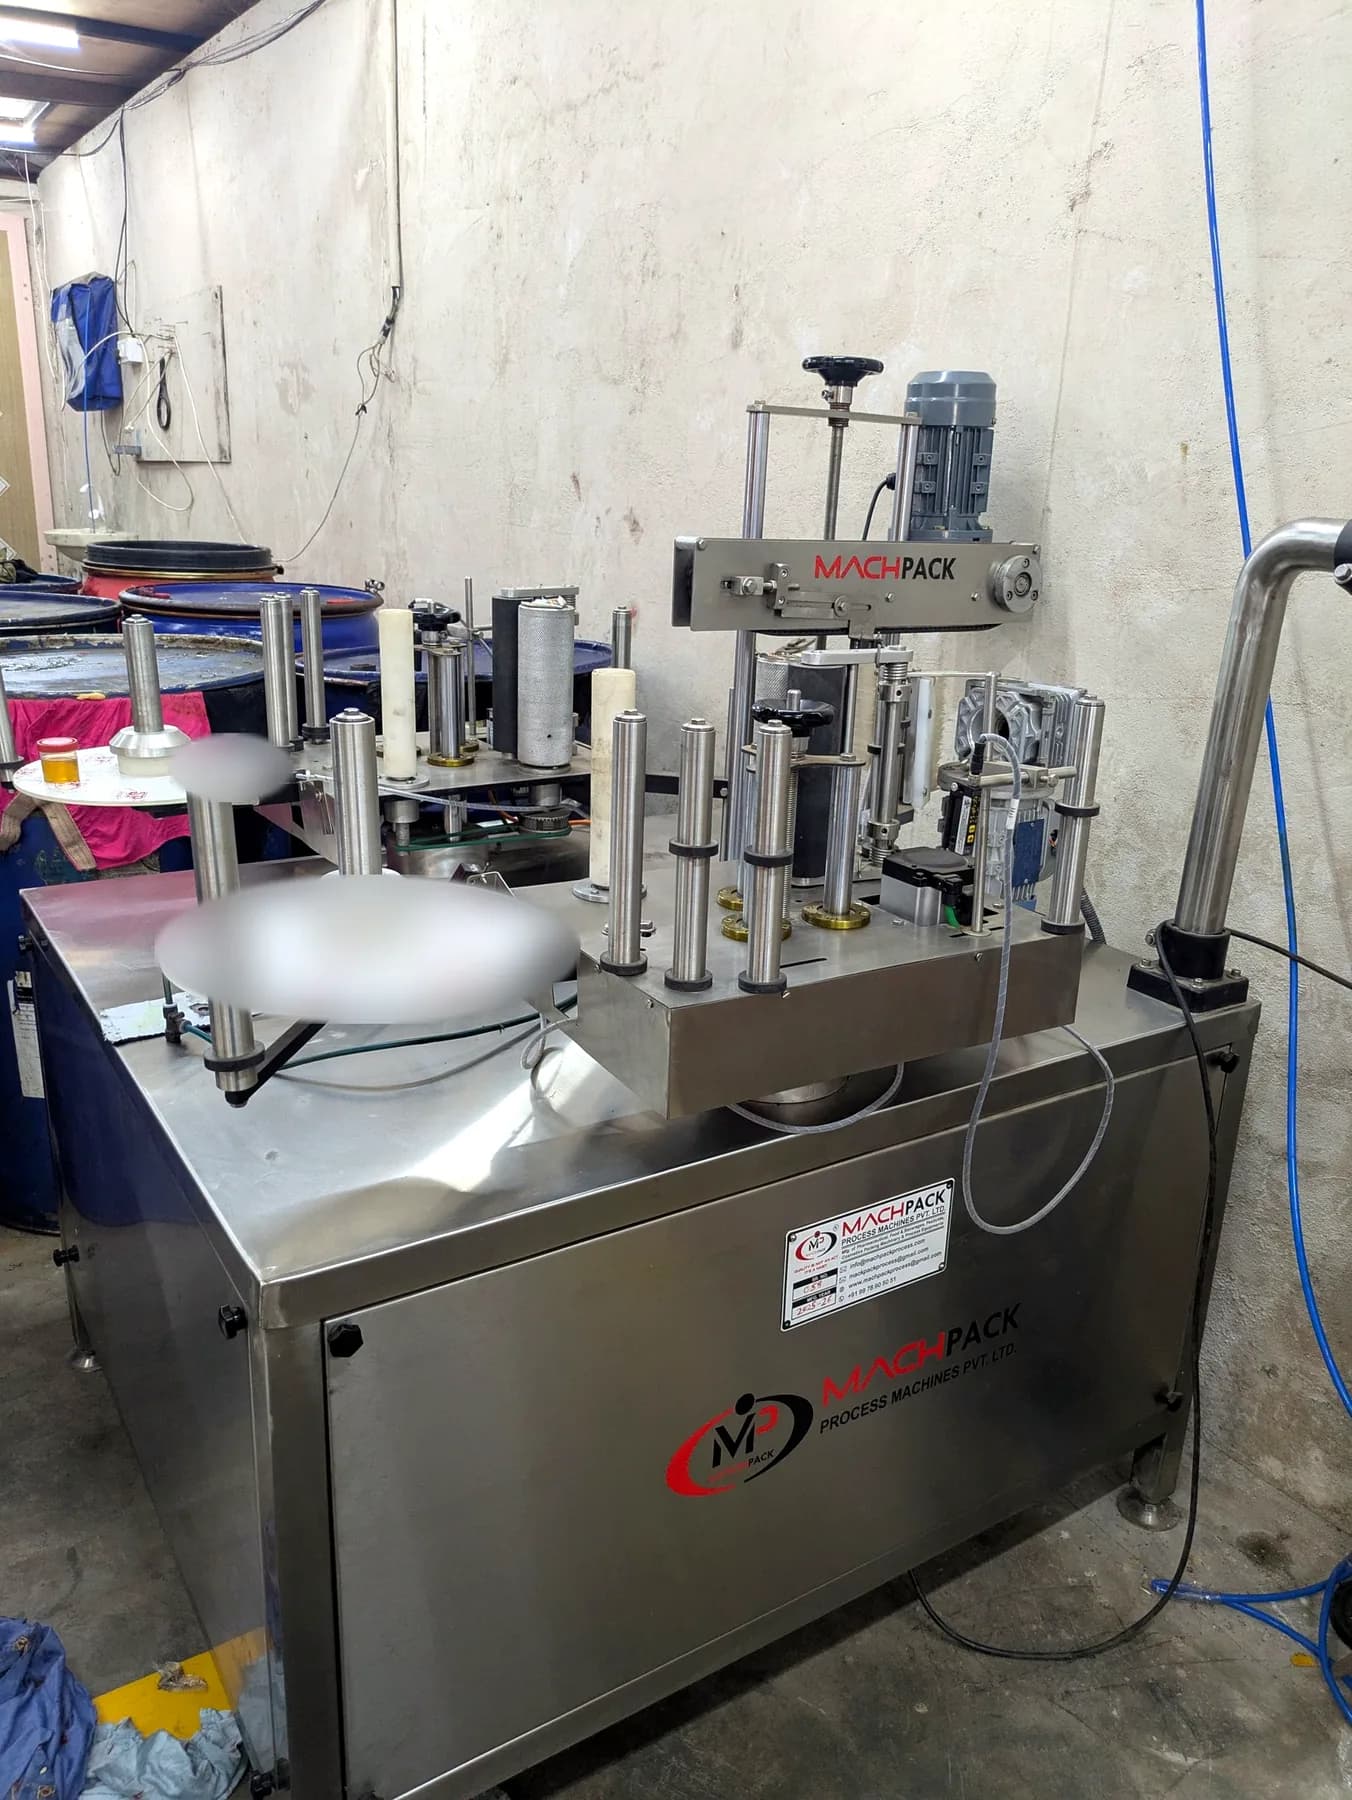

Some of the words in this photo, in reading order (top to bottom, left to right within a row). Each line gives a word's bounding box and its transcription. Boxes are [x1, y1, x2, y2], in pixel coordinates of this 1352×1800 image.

[815, 555, 956, 580] MACHPACK
[841, 1228, 876, 1246] PROCESS
[878, 1216, 914, 1233] MACHINES
[842, 1189, 945, 1236] MACHPACK
[822, 1302, 1021, 1407] MACHPACK
[820, 1394, 888, 1434] PROCESS
[890, 1366, 960, 1404] MACHINES
[962, 1354, 988, 1376] PVT.
[992, 1342, 1017, 1363] LTD.
